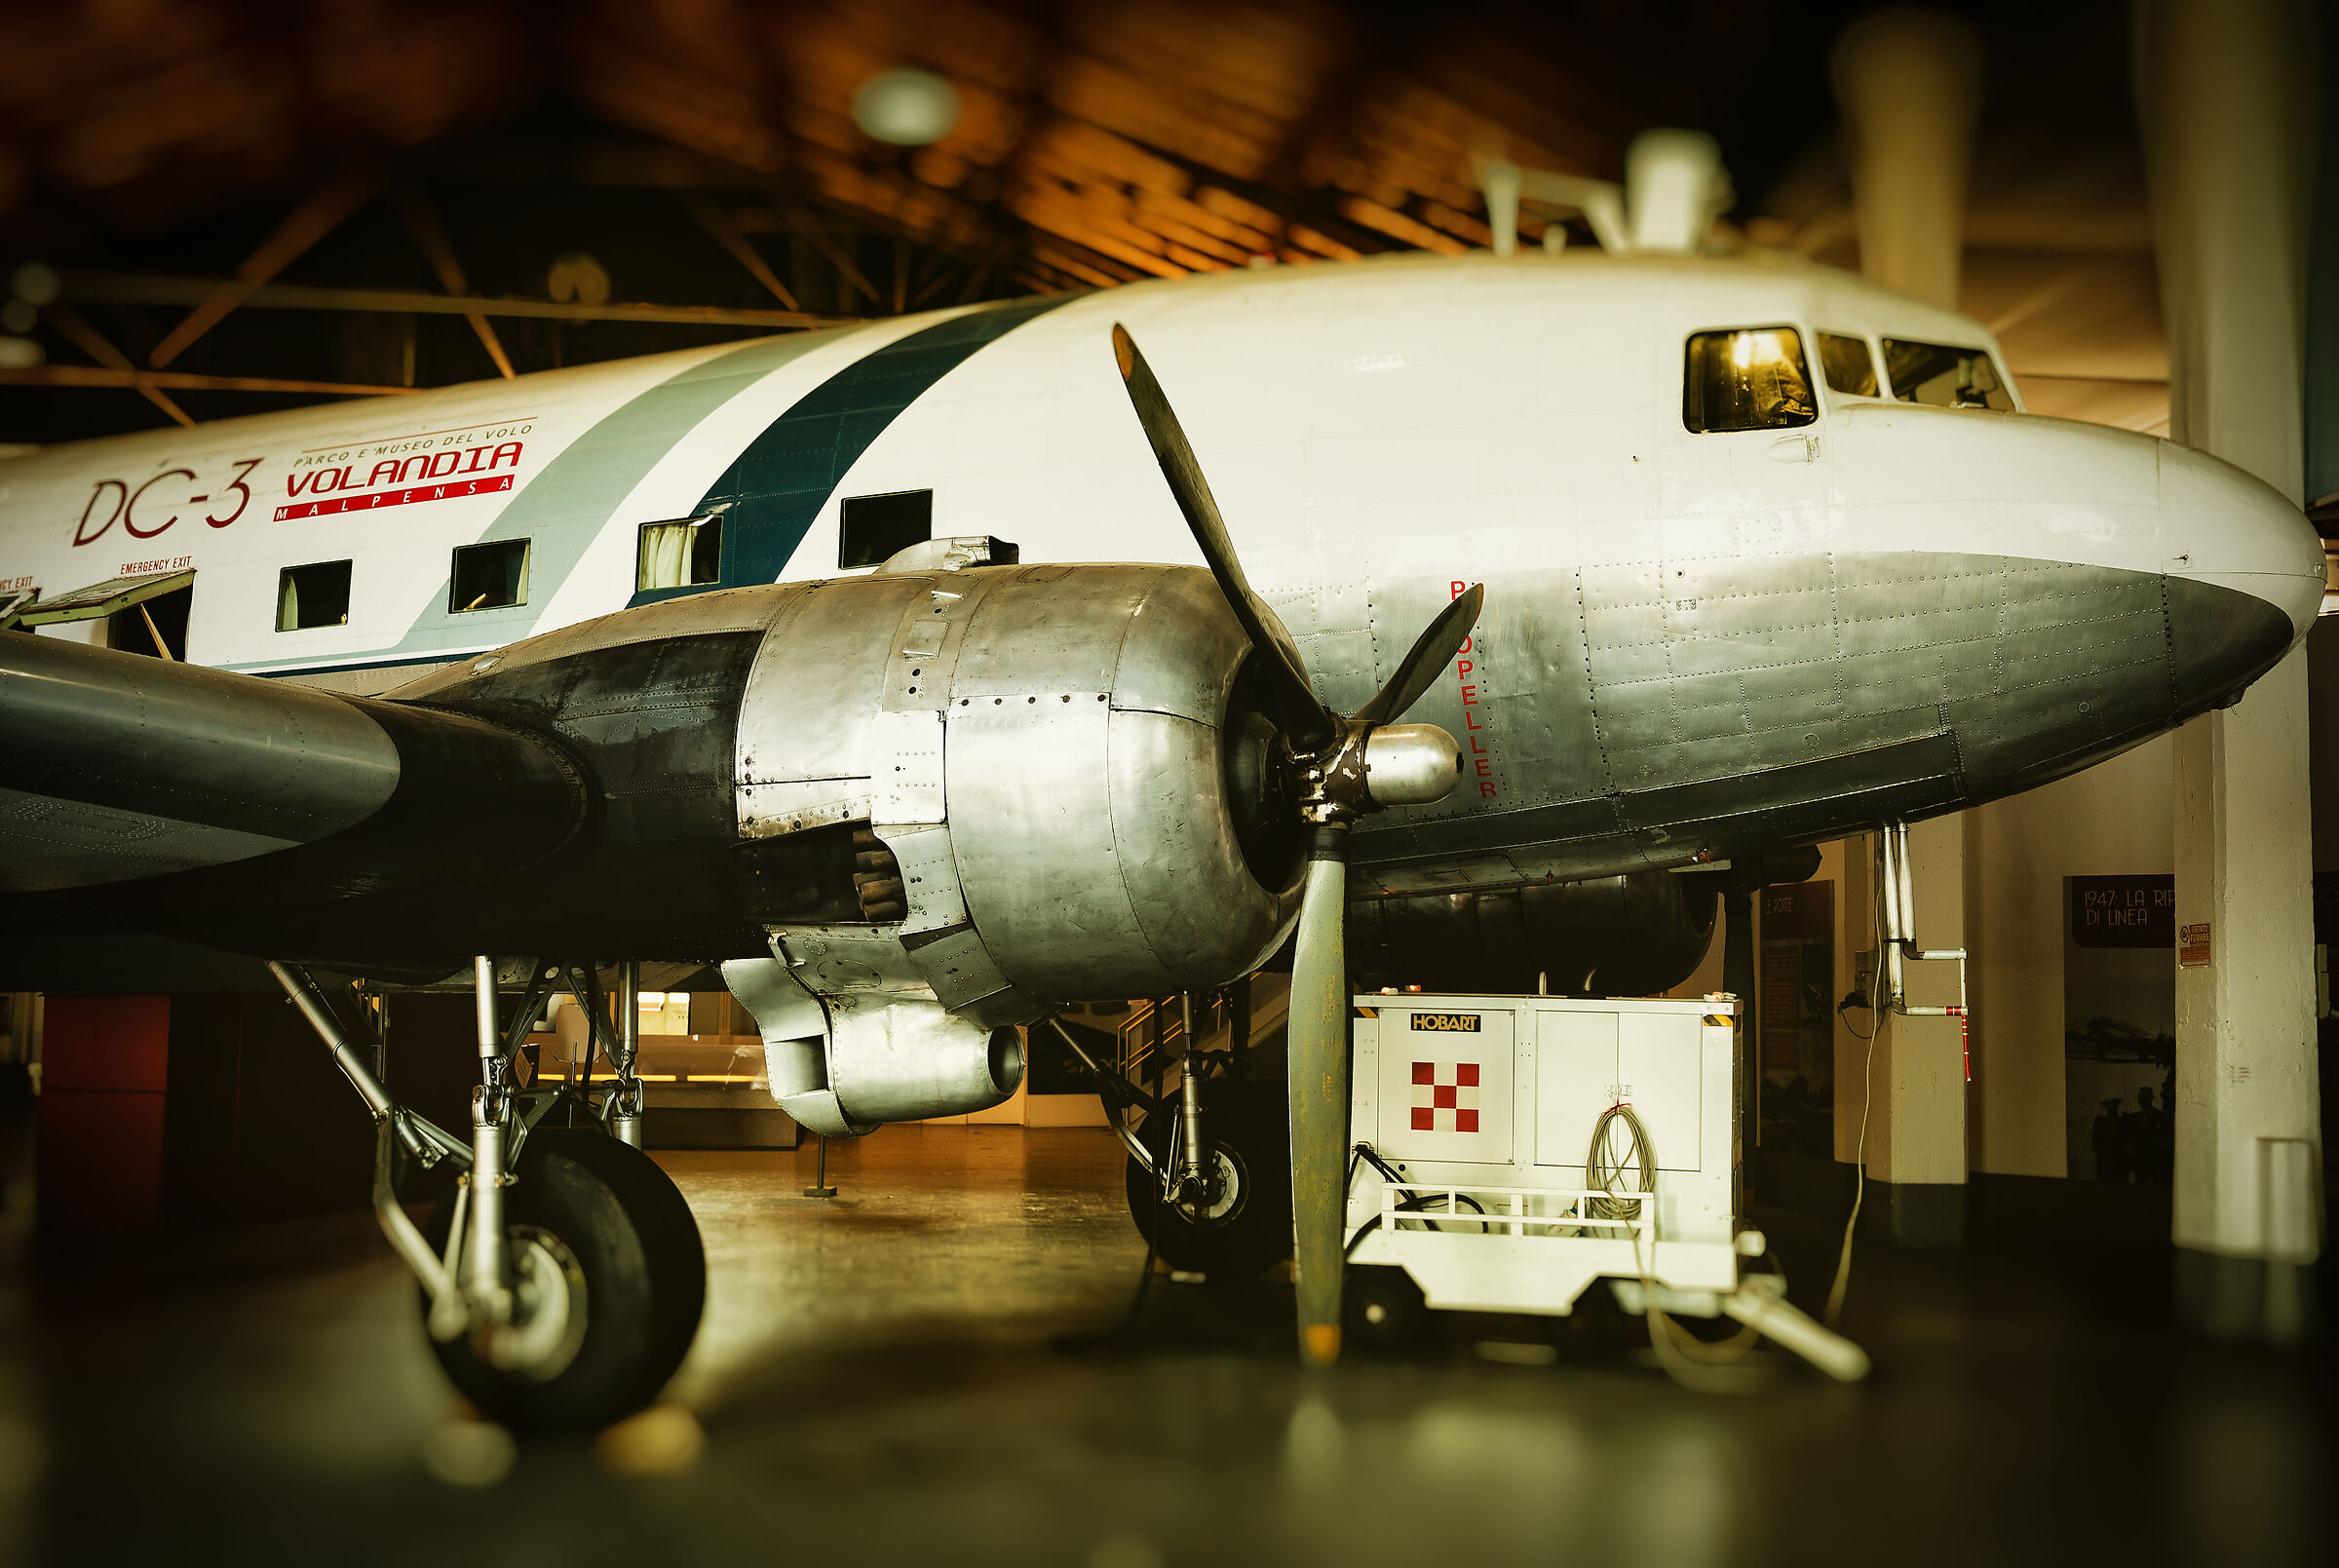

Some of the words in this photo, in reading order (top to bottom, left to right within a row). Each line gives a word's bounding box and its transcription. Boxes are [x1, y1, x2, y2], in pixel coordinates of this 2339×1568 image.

[294, 451, 350, 468] PARCO
[358, 449, 367, 459] E
[374, 440, 435, 456] MUSEO
[442, 433, 474, 446] DEL
[485, 425, 532, 440] VOLO
[287, 441, 524, 498] VOLANDIA
[72, 457, 265, 547] DC-3
[276, 478, 510, 520] MALPENSA
[120, 558, 171, 575] EMERGENCY
[173, 555, 193, 568] EXIT
[16, 576, 33, 588] EXIT
[1450, 581, 1498, 798] POPELLER
[2127, 889, 2145, 906] LA
[2086, 908, 2100, 926] DI
[2108, 908, 2148, 926] LINEA
[1413, 1014, 1477, 1031] HOBART
